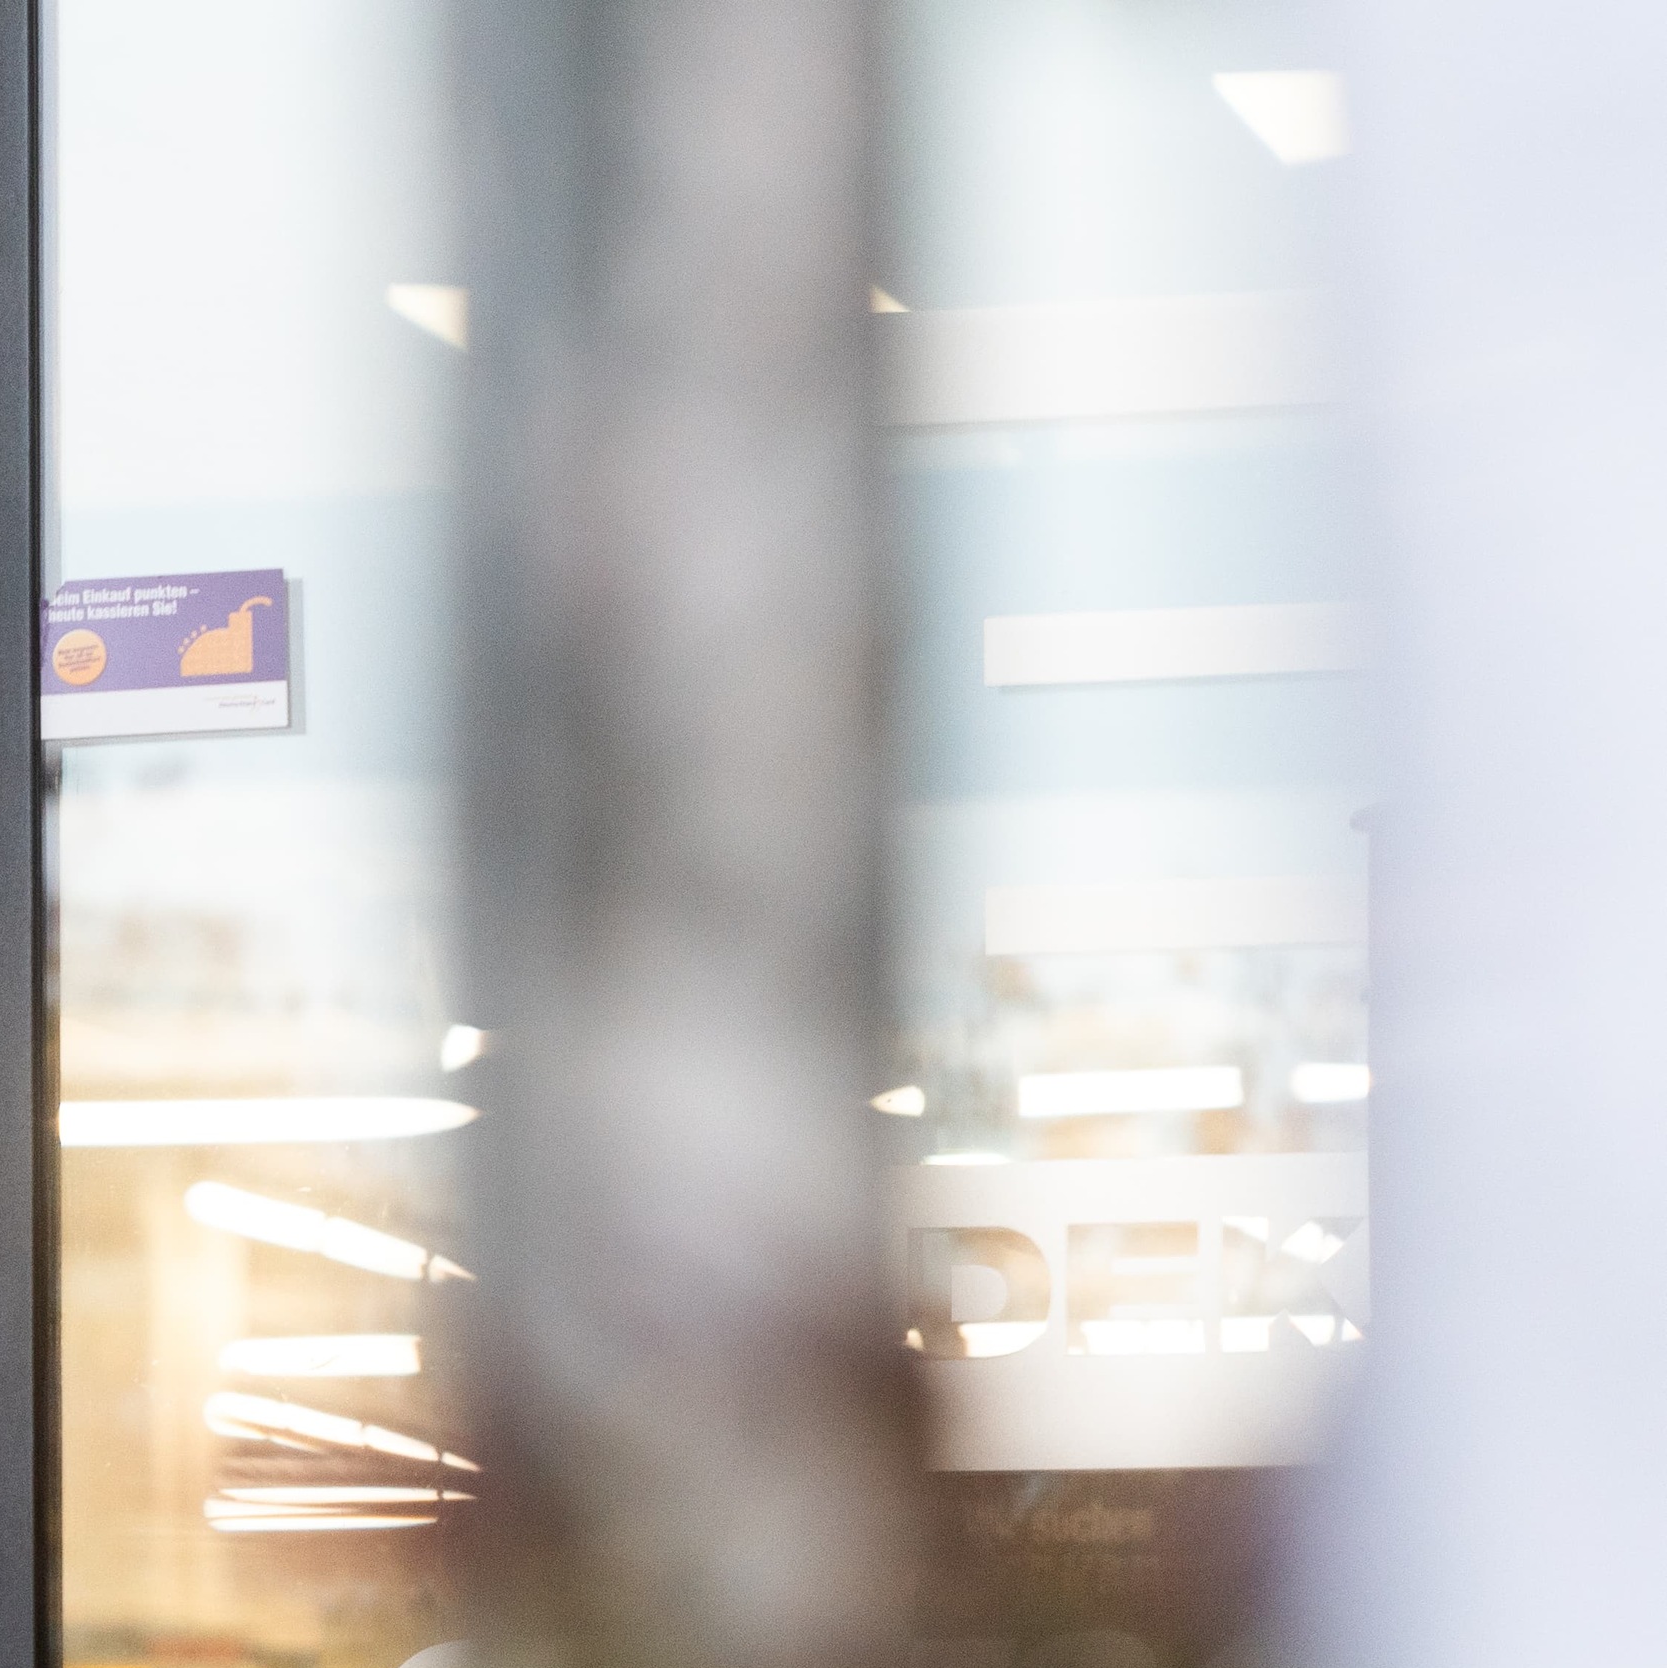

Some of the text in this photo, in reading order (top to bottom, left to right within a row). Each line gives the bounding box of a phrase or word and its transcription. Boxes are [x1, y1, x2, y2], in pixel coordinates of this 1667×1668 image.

[54, 591, 80, 606] eim
[83, 587, 131, 604] Einkauf
[134, 585, 187, 604] punkten
[48, 600, 177, 623] heute kassieren Sie!
[907, 1216, 1367, 1362] DEK
